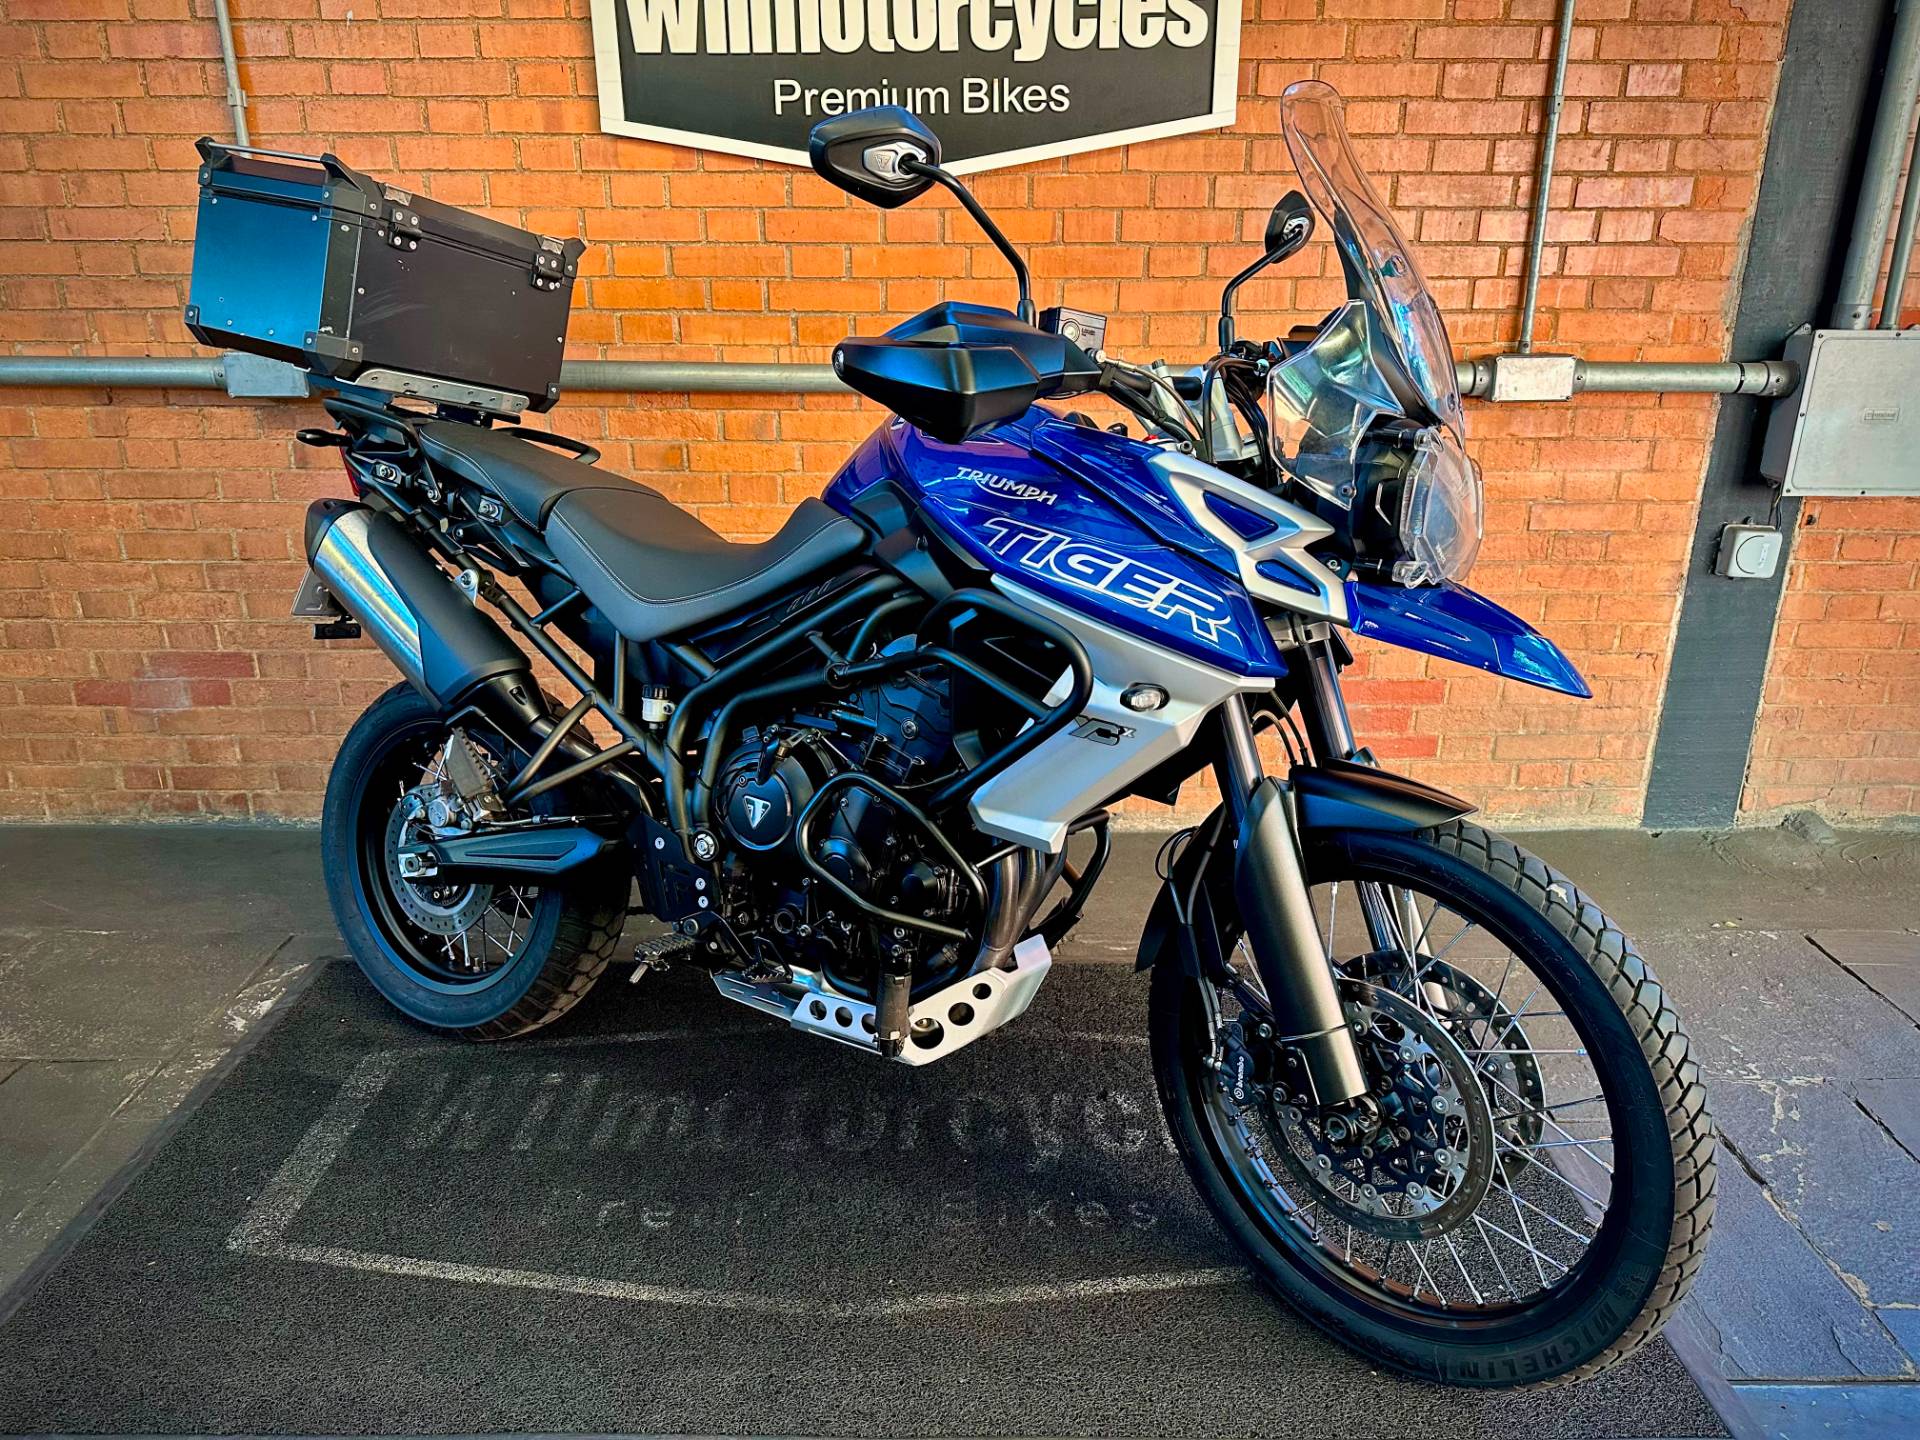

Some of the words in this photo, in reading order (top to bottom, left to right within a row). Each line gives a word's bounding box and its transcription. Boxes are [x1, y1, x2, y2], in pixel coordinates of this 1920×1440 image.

[773, 78, 950, 116] Premium
[956, 466, 1059, 506] TRIUMPH
[983, 516, 1231, 644] TIGER
[1457, 1302, 1620, 1380] MICHELIN
